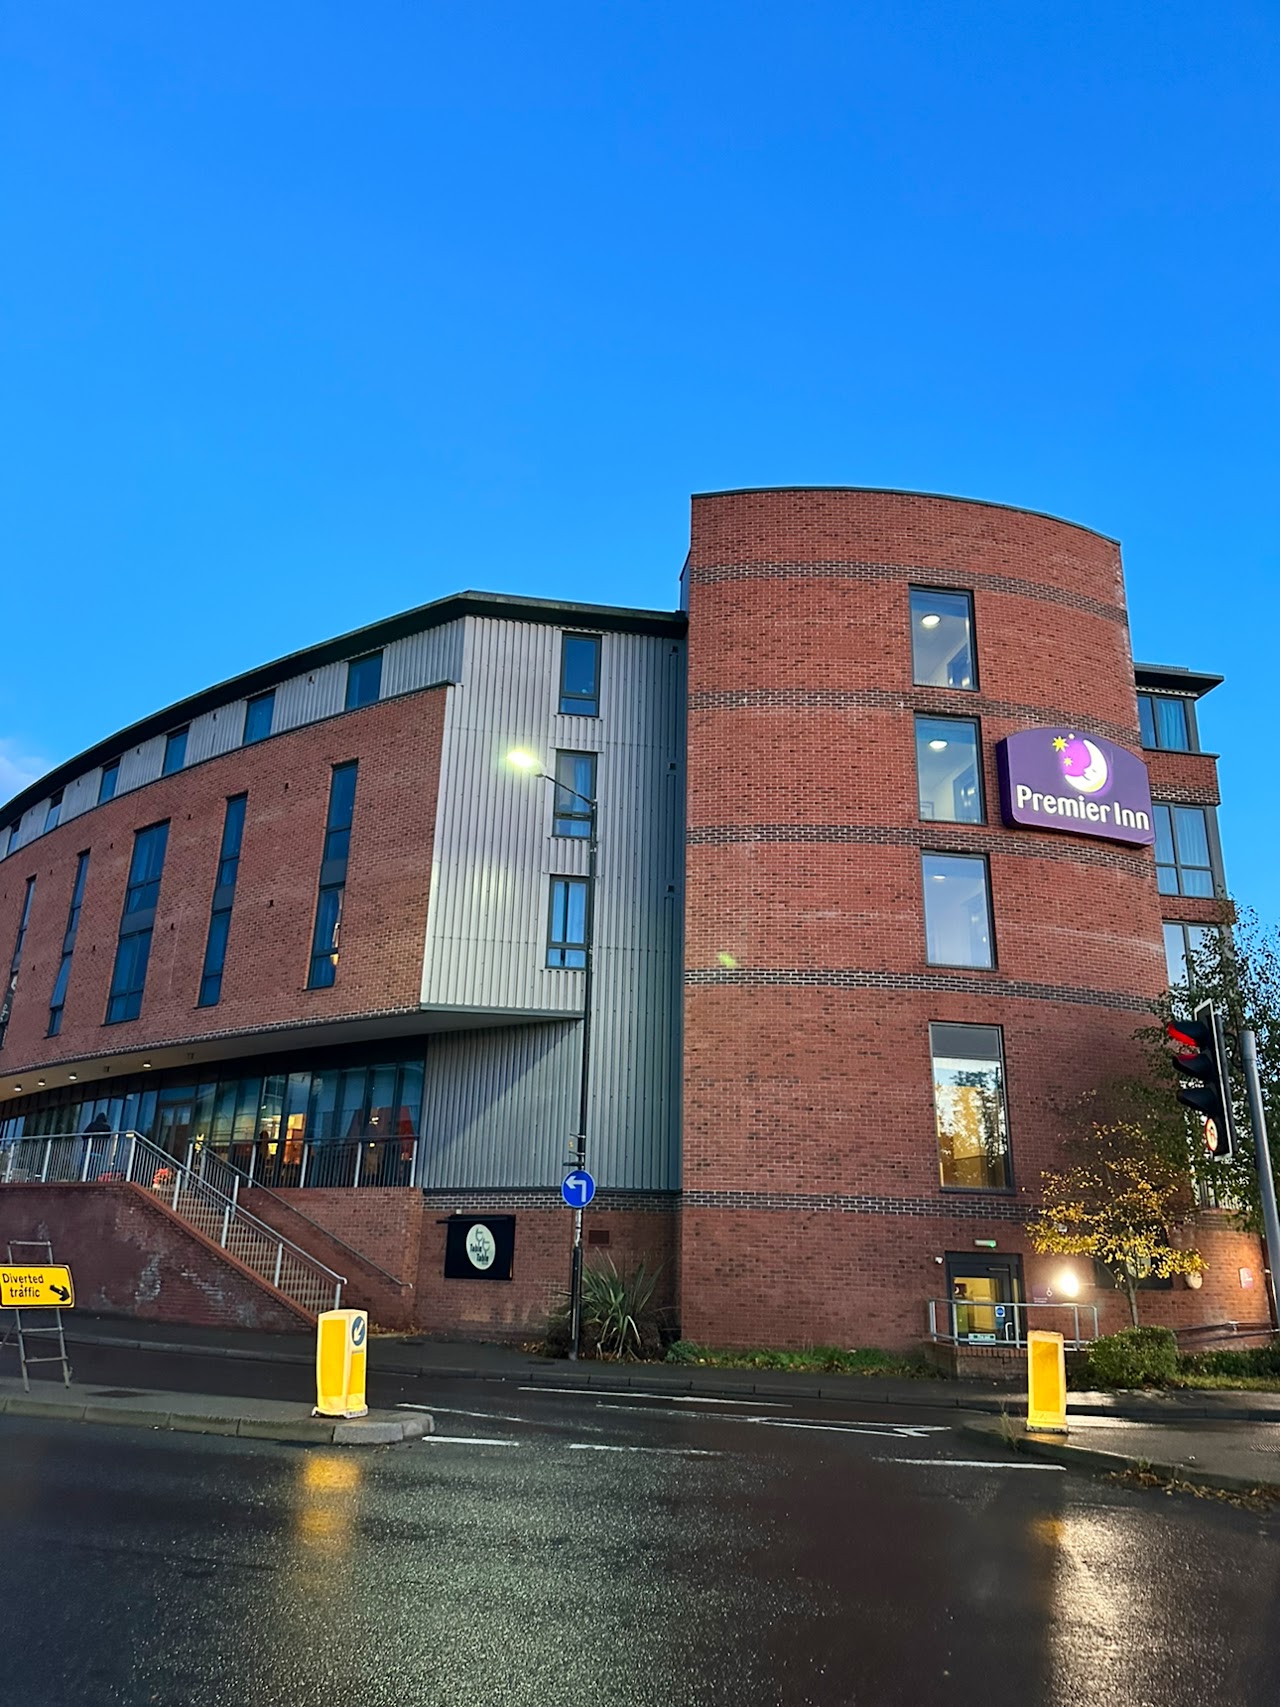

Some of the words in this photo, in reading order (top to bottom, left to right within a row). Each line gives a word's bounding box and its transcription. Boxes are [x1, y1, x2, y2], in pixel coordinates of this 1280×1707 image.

[1016, 784, 1111, 823] Premier
[1114, 802, 1150, 831] Inn
[2, 1273, 44, 1284] Diverted
[9, 1286, 41, 1298] traffic
